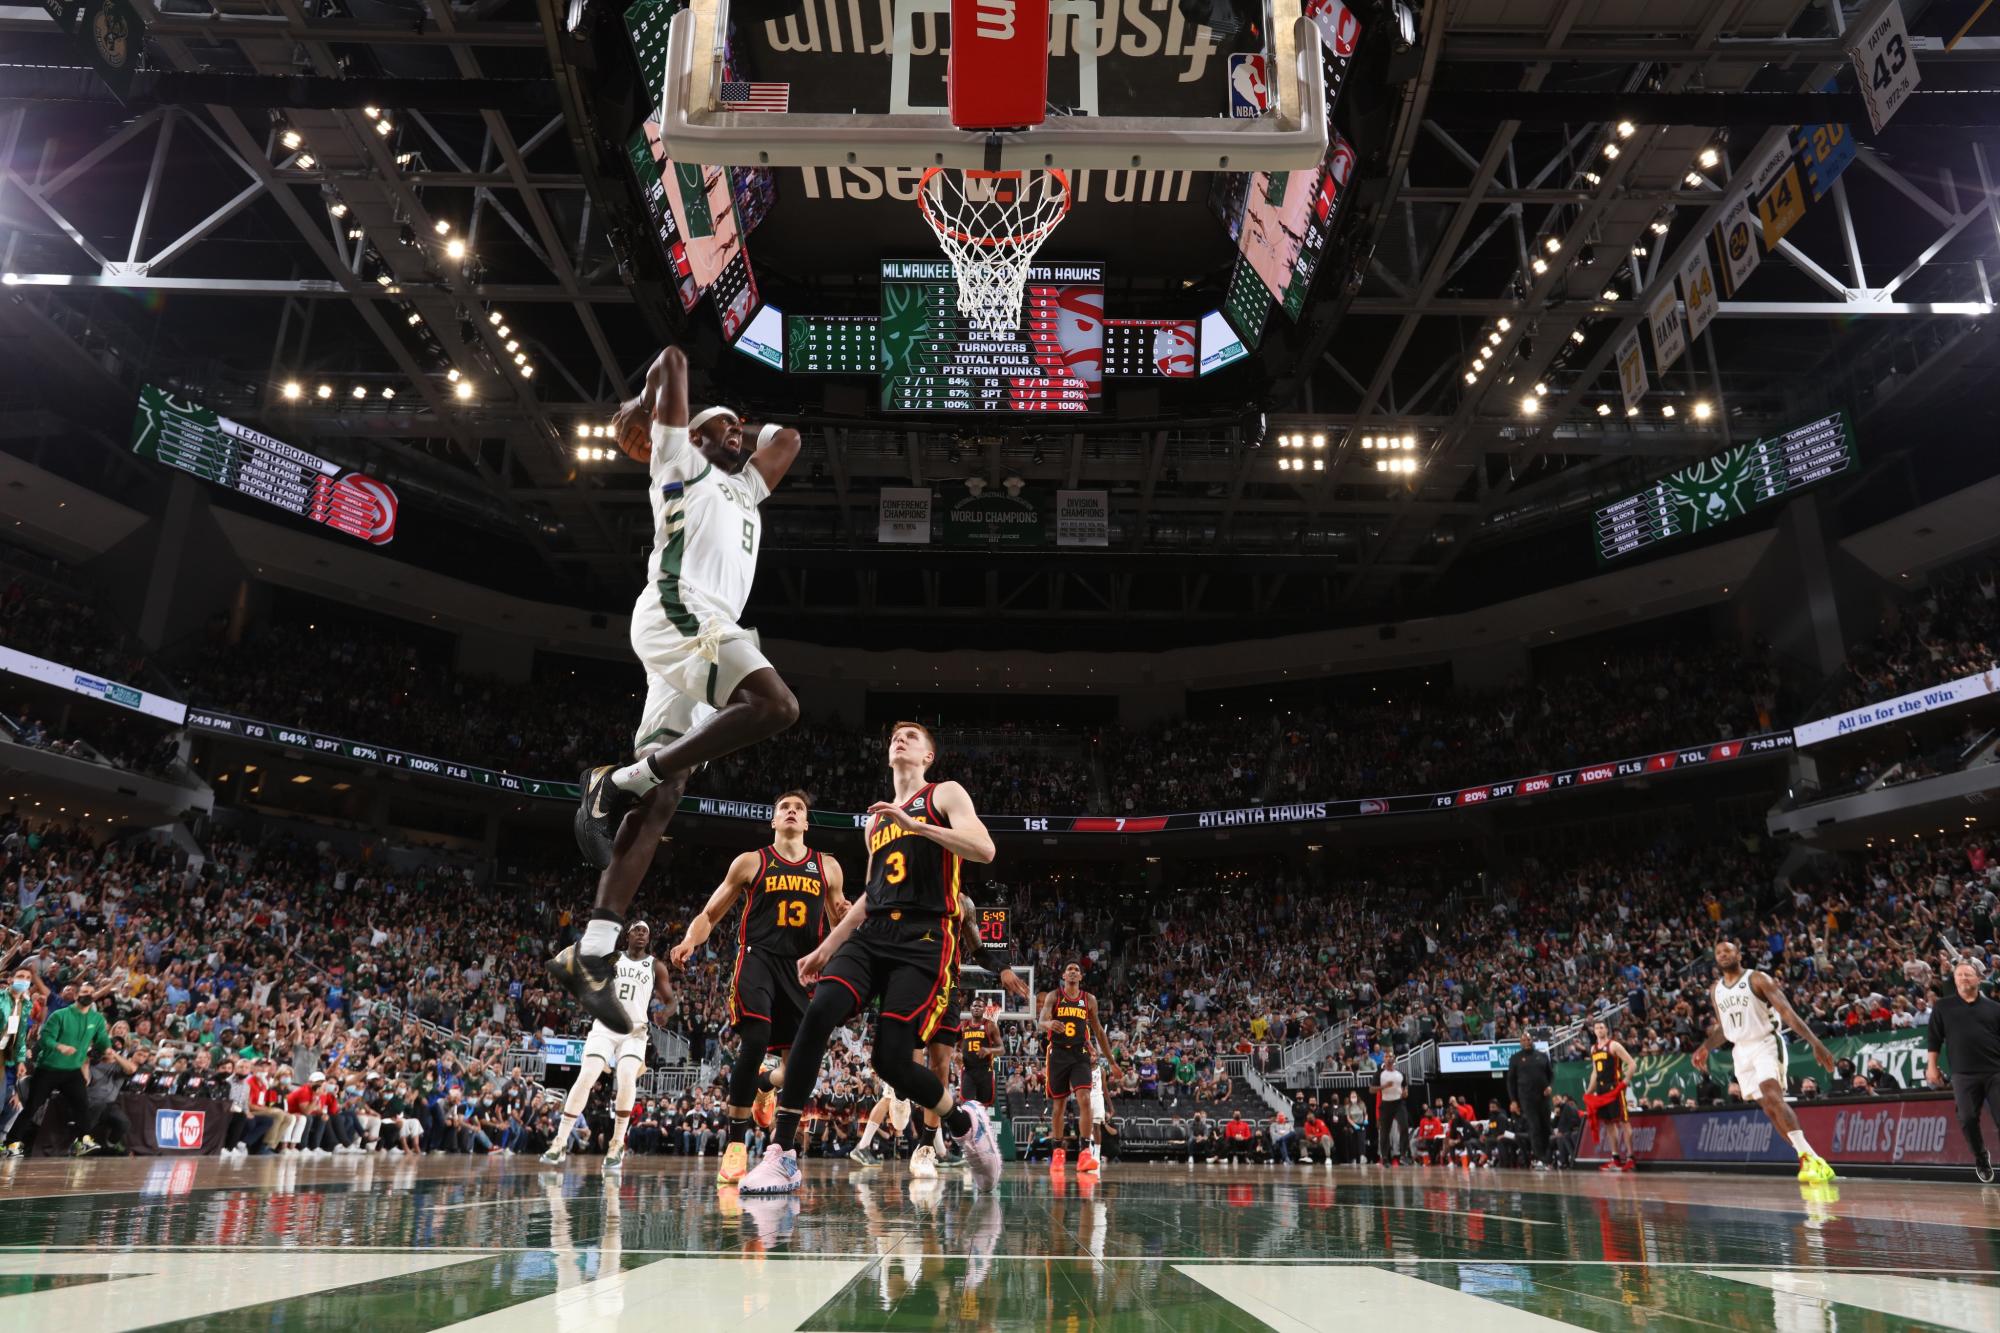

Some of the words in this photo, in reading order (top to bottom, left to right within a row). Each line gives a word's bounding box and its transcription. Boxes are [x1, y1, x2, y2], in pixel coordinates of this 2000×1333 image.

[1868, 18, 1891, 51] TATUM
[1873, 34, 1907, 91] 43
[1236, 106, 1253, 117] NBA
[652, 178, 664, 200] 18
[1320, 190, 1330, 206] 7
[1766, 178, 1792, 222] 14
[664, 209, 676, 233] 6:49
[660, 225, 669, 241] 1st
[1305, 225, 1317, 249] 6:49
[1314, 234, 1324, 250] 1st
[1730, 227, 1748, 257] 24
[677, 251, 686, 263] 7
[882, 263, 949, 278] MILWAUKEE
[1055, 265, 1100, 280] HAWKS
[1296, 257, 1308, 276] 18
[1690, 267, 1712, 310] 44
[1656, 308, 1678, 346] HANK
[958, 344, 1026, 352] TURNOVERS
[955, 355, 986, 364] TOTAL
[989, 356, 1029, 364] FOULS
[943, 366, 960, 375] PTS
[963, 367, 999, 375] FROM
[1002, 367, 1041, 376] DUNKS
[926, 377, 934, 385] 11
[948, 378, 969, 386] 64%
[984, 379, 999, 387] FG
[1062, 380, 1084, 388] 20%
[949, 390, 969, 398] 67%
[981, 390, 1002, 398] 3PT
[1062, 391, 1084, 399] 20%
[944, 401, 969, 409] 100%
[1058, 402, 1083, 410] 100%
[1786, 419, 1831, 440] TURNOVERS
[236, 426, 323, 470] LEADERBOARD
[1786, 442, 1804, 453] FAST
[1805, 430, 1835, 445] BREAKS
[1790, 452, 1810, 462] FIELD
[1811, 441, 1836, 454] GOALS
[254, 448, 269, 460] PTS
[270, 456, 302, 473] LEADER
[1789, 464, 1808, 475] FREE
[1808, 451, 1841, 467] THROWS
[241, 464, 276, 482] ASSISTS
[277, 478, 308, 495] LEADER
[270, 465, 300, 482] LEADER
[1802, 467, 1831, 482] THREES
[240, 474, 272, 491] BLOCKS
[273, 487, 304, 503] LEADER
[239, 483, 270, 500] STEALS
[271, 496, 303, 512] LEADER
[1067, 498, 1098, 508] DIVISION
[882, 501, 928, 509] CONFERENCE
[1606, 497, 1638, 514] REBOUNDS
[884, 510, 926, 519] CHAMPIONS
[950, 510, 983, 522] WORLD
[985, 511, 1037, 523] CHAMPIONS
[1061, 508, 1104, 518] CHAMPIONS
[1612, 509, 1635, 522] BLOCKS
[1614, 520, 1636, 532] STEALS
[742, 518, 754, 556] 9
[1614, 530, 1639, 543] ASSISTS
[1618, 541, 1638, 552] DUNKS
[1838, 717, 1856, 731] All
[1859, 713, 1872, 725] in
[1875, 708, 1894, 722] for
[1898, 699, 1922, 714] the
[1923, 689, 1954, 706] Win
[188, 714, 211, 725] 7:43
[214, 718, 231, 729] PM
[246, 725, 264, 737] FG
[279, 732, 307, 745] 64%
[1750, 738, 1775, 750] 7:43
[1776, 736, 1793, 747] PM
[315, 739, 340, 752] 3PT
[352, 747, 377, 760] 67%
[386, 753, 401, 765] FT
[1680, 751, 1705, 763] TOL
[410, 758, 438, 773] 100%
[447, 766, 468, 778] FLS
[1618, 763, 1642, 775] FLS
[1557, 775, 1572, 786] FT
[1581, 768, 1612, 782] 100%
[500, 777, 520, 789] TOL
[533, 784, 540, 793] 7
[1526, 780, 1549, 792] 20%
[1465, 791, 1487, 802] 20%
[1493, 785, 1514, 797] 3PT
[1437, 797, 1451, 806] FG
[700, 800, 764, 819] MILWAUKEE
[1199, 809, 1265, 828] ATLANTA
[1270, 804, 1327, 822] HAWKS
[1024, 818, 1048, 830] 1st
[1115, 819, 1126, 831] 7
[885, 851, 907, 884] 3
[765, 875, 820, 896] HAWKS
[777, 900, 806, 927] 13
[983, 911, 1005, 921] 6:49
[980, 922, 1002, 940] 20
[619, 983, 636, 1000] 21
[1718, 995, 1749, 1013] BUCKS
[1057, 1007, 1087, 1020] HAWKS
[1729, 1012, 1742, 1028] 17
[964, 1031, 985, 1039] HAWKS
[1064, 1023, 1075, 1036] 6
[968, 1041, 981, 1051] 15
[1452, 1051, 1489, 1061] Froedtert
[1698, 1110, 1772, 1153] #ThatsGame
[1847, 1110, 1893, 1153] that's
[1895, 1116, 1947, 1160] game
